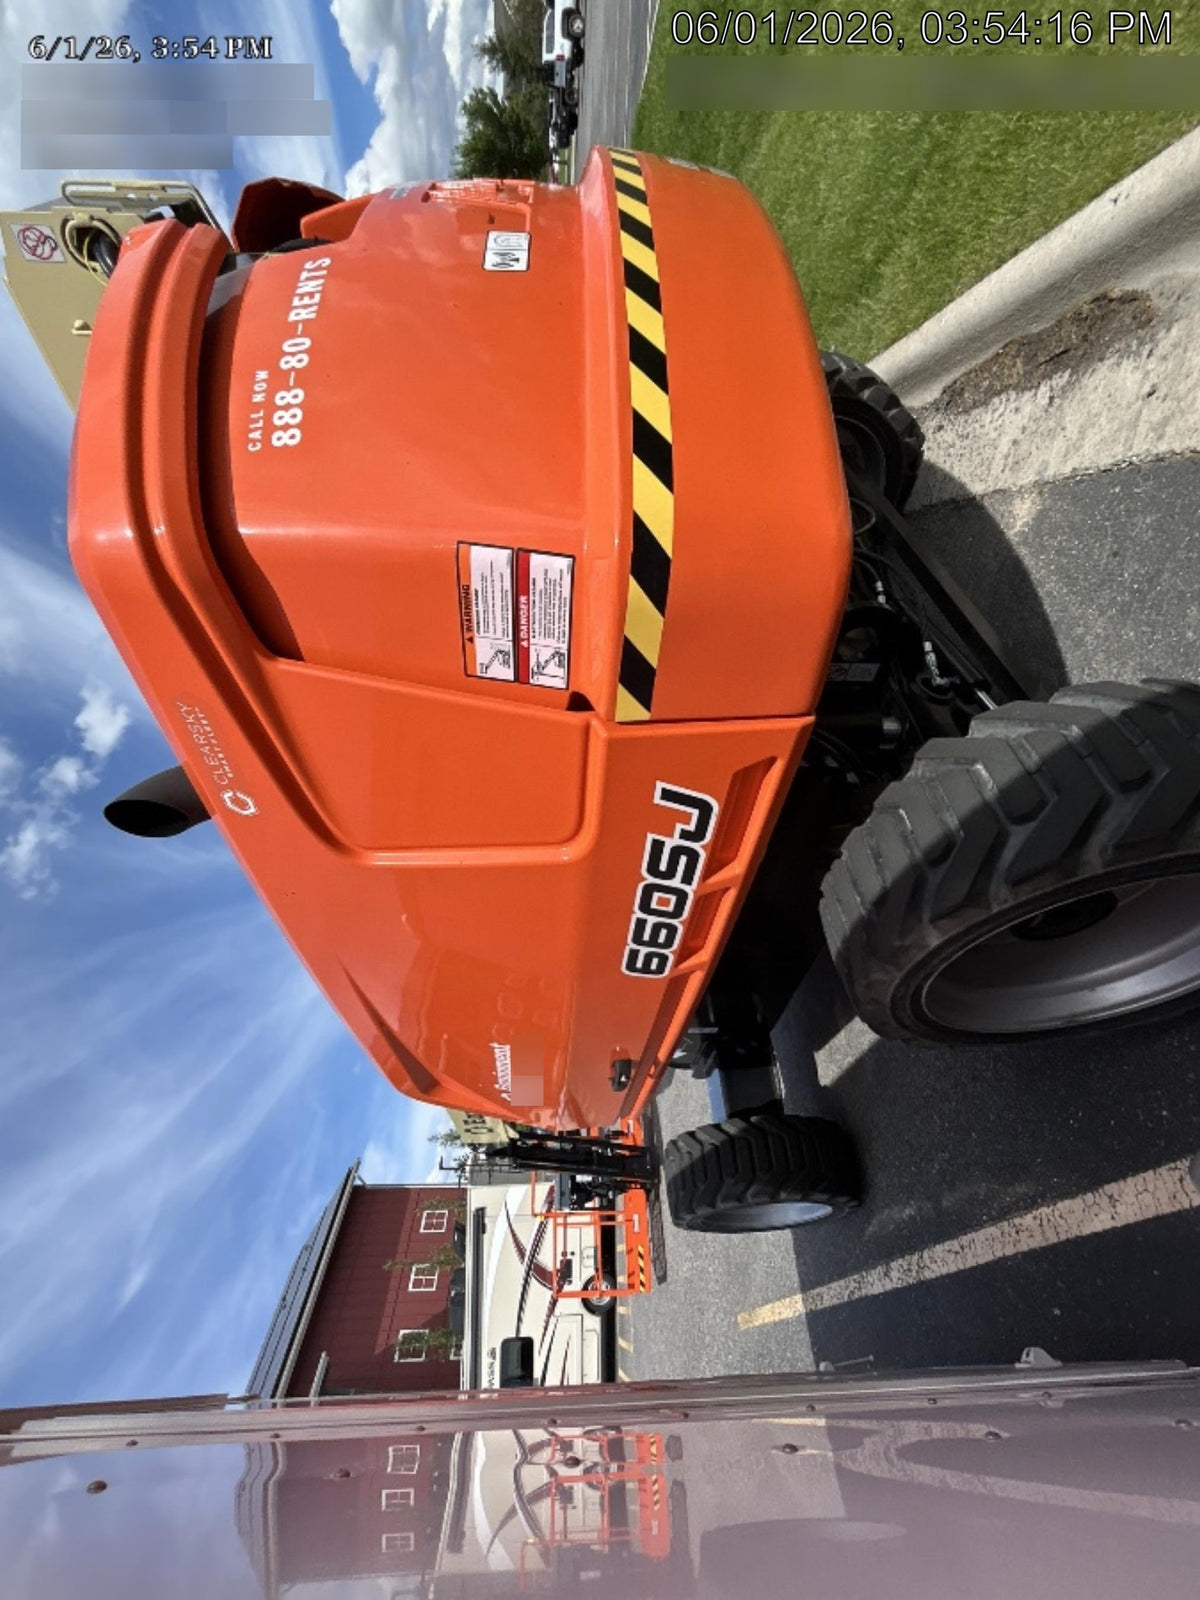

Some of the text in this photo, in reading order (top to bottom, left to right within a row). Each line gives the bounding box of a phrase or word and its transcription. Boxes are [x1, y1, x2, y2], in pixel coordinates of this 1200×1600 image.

[270, 257, 332, 448] 888-80-RENTS
[248, 370, 269, 452] CALL NOW
[463, 585, 473, 633] WARNING
[520, 595, 529, 639] DANGER
[176, 702, 228, 785] CLEARSKY
[621, 781, 720, 979] 660SJ
